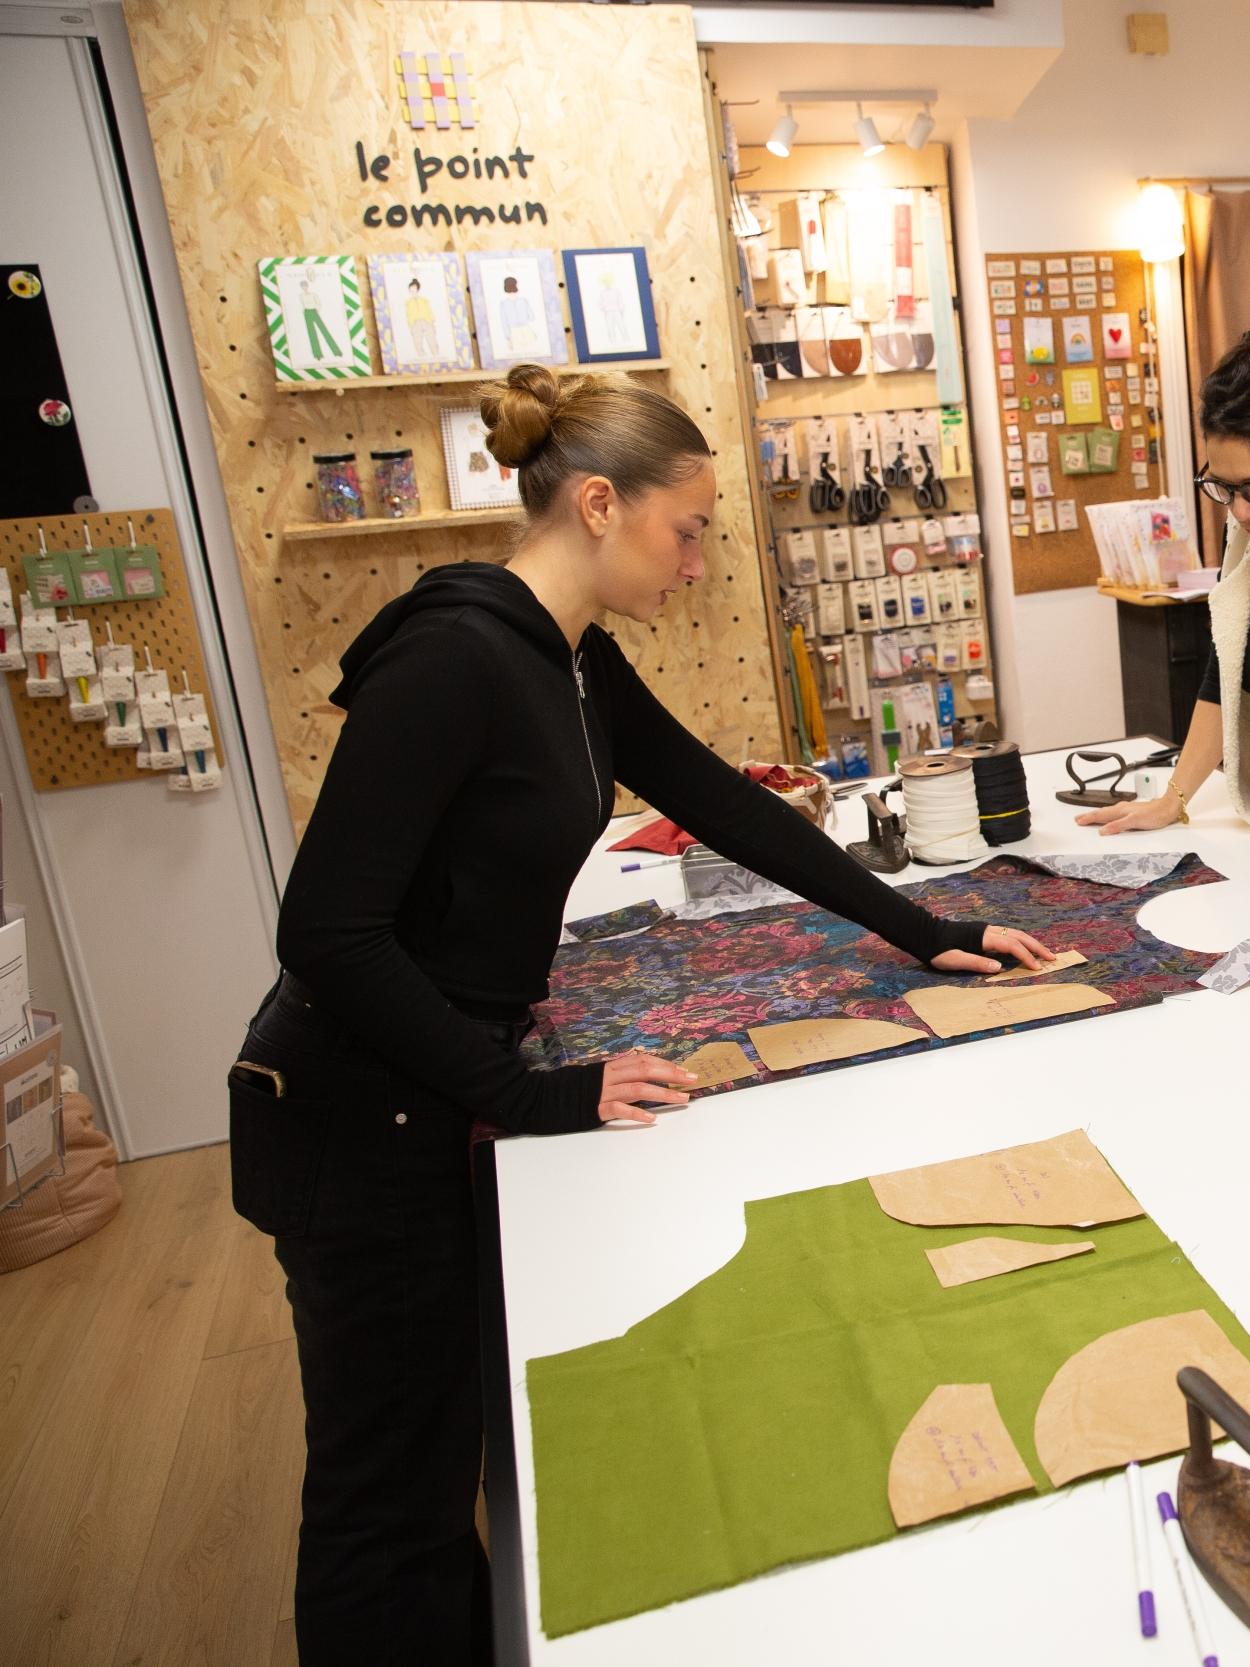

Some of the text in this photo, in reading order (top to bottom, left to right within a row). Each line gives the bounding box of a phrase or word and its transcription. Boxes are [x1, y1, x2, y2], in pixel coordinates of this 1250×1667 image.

[356, 141, 535, 194] le point
[363, 201, 548, 228] commun
